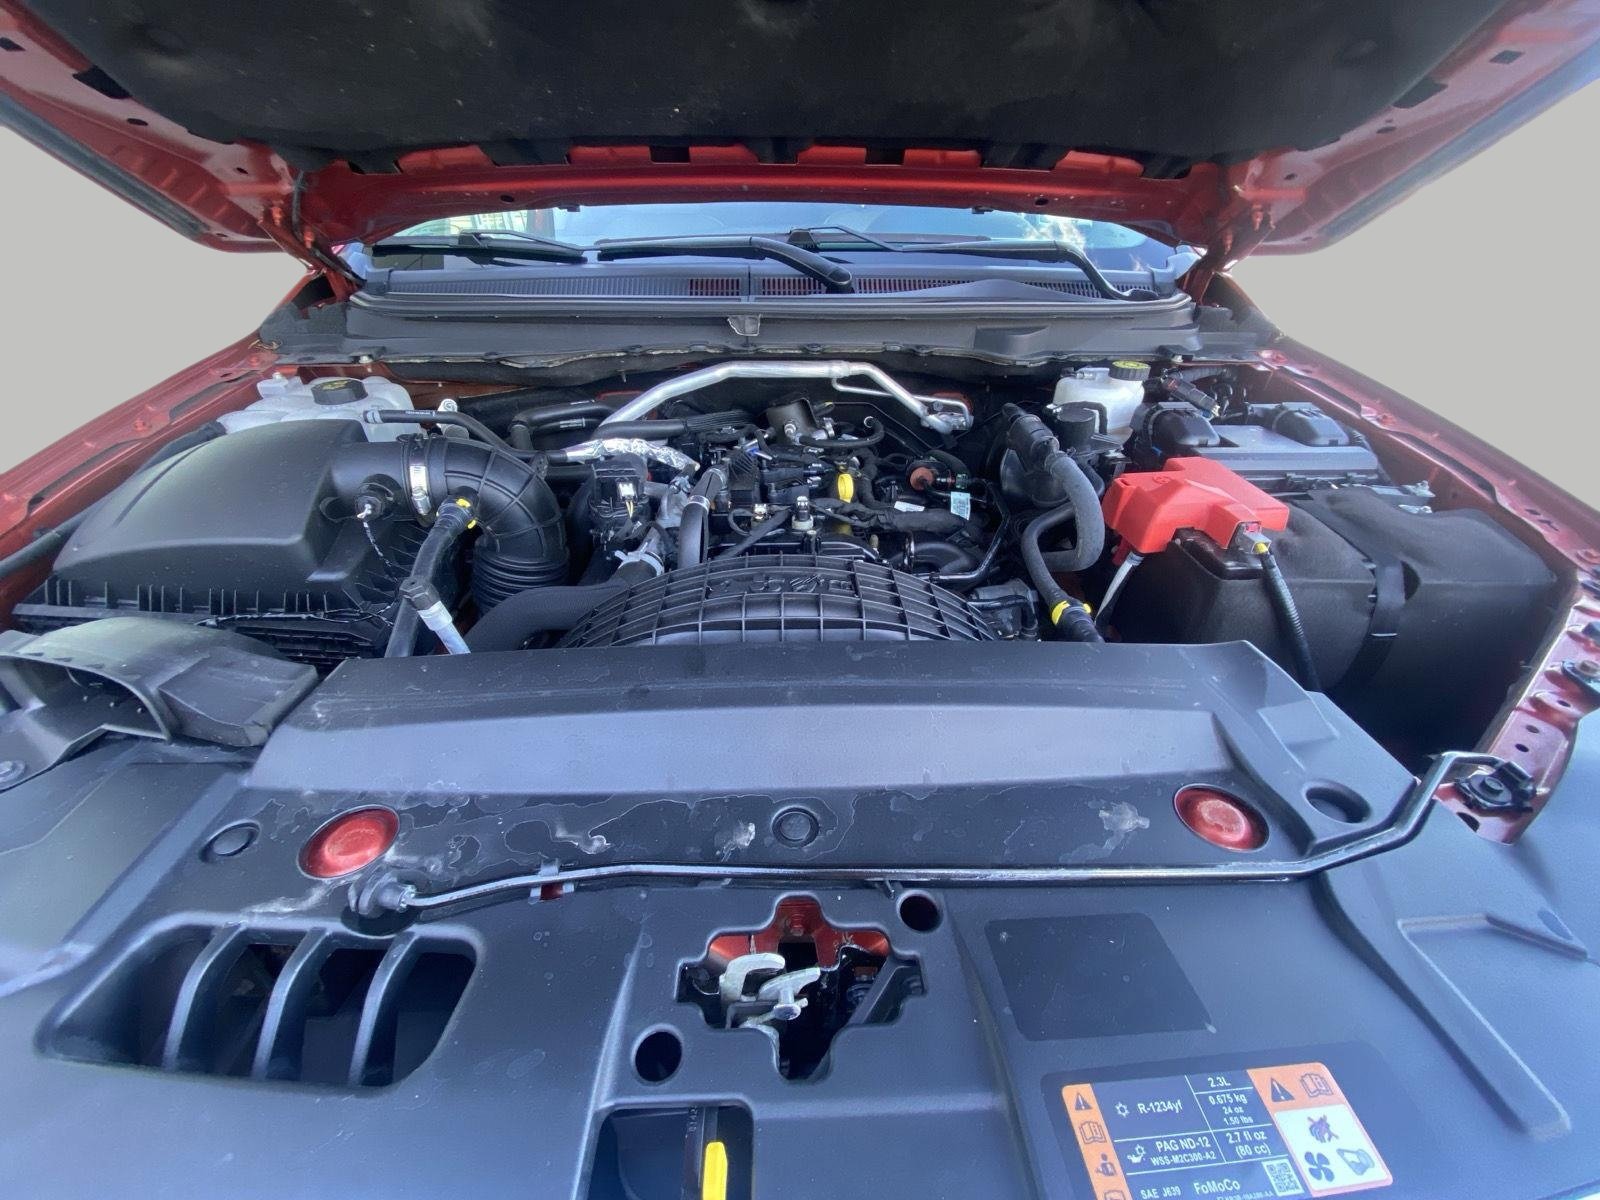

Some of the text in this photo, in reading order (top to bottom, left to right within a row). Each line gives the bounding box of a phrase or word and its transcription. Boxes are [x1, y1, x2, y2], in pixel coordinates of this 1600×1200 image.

[1207, 1076, 1231, 1088] 2.3L
[1208, 1092, 1248, 1106] 0.675 kg
[1137, 1099, 1183, 1114] R-1234yf
[1222, 1106, 1233, 1115] 24
[1223, 1116, 1254, 1126] 1.50 lbs
[1226, 1131, 1268, 1144] 2.7 fl oz
[1155, 1136, 1211, 1153] PAG ND-12
[1235, 1142, 1272, 1159] (80 cc)
[1193, 1179, 1241, 1195] FoMoCo
[1140, 1188, 1160, 1200] SAE
